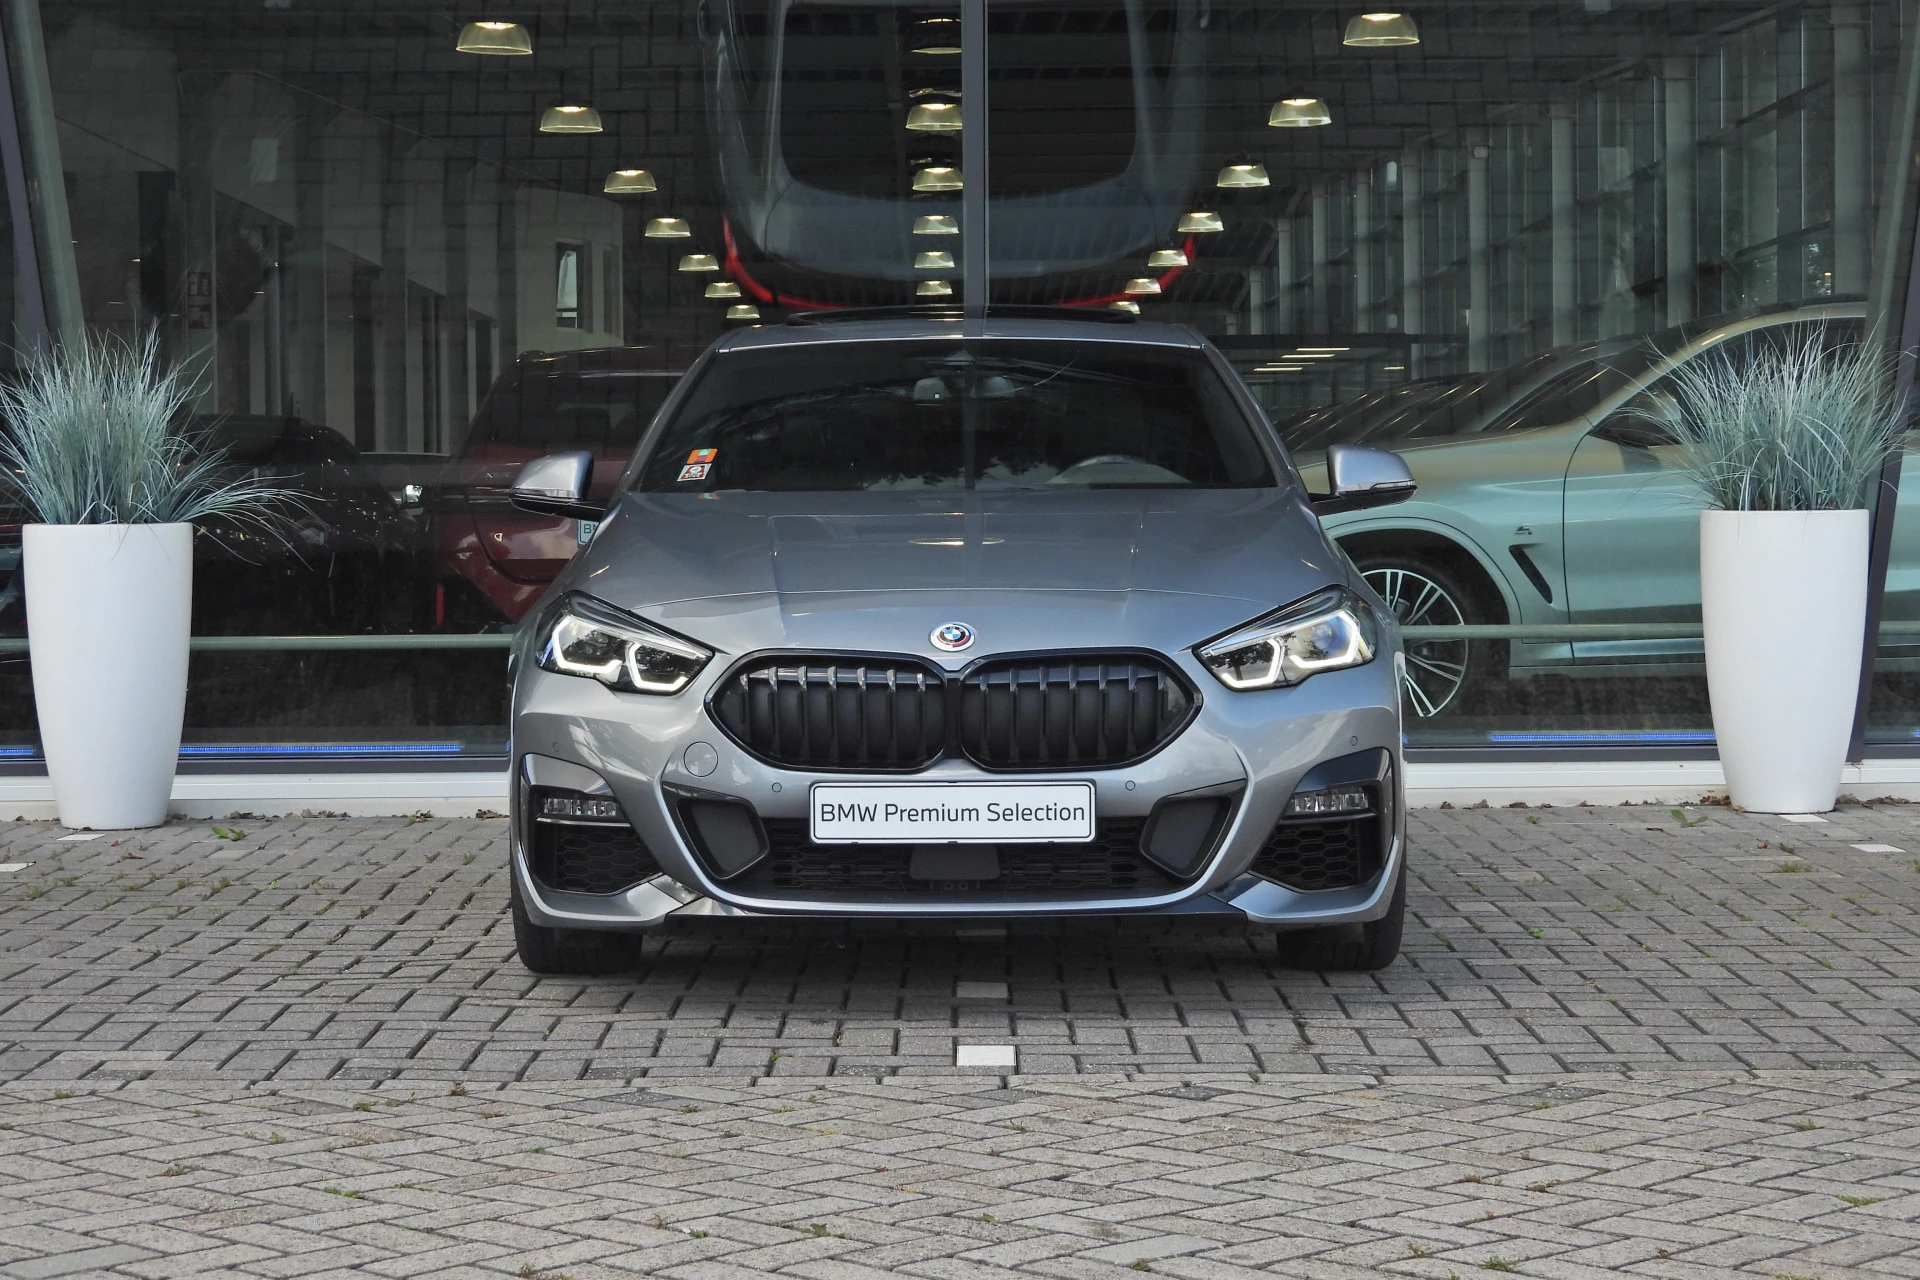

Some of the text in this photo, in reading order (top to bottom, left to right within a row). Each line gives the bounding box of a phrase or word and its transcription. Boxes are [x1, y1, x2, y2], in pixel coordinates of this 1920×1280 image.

[821, 802, 1085, 822] BMW Premium Selection
